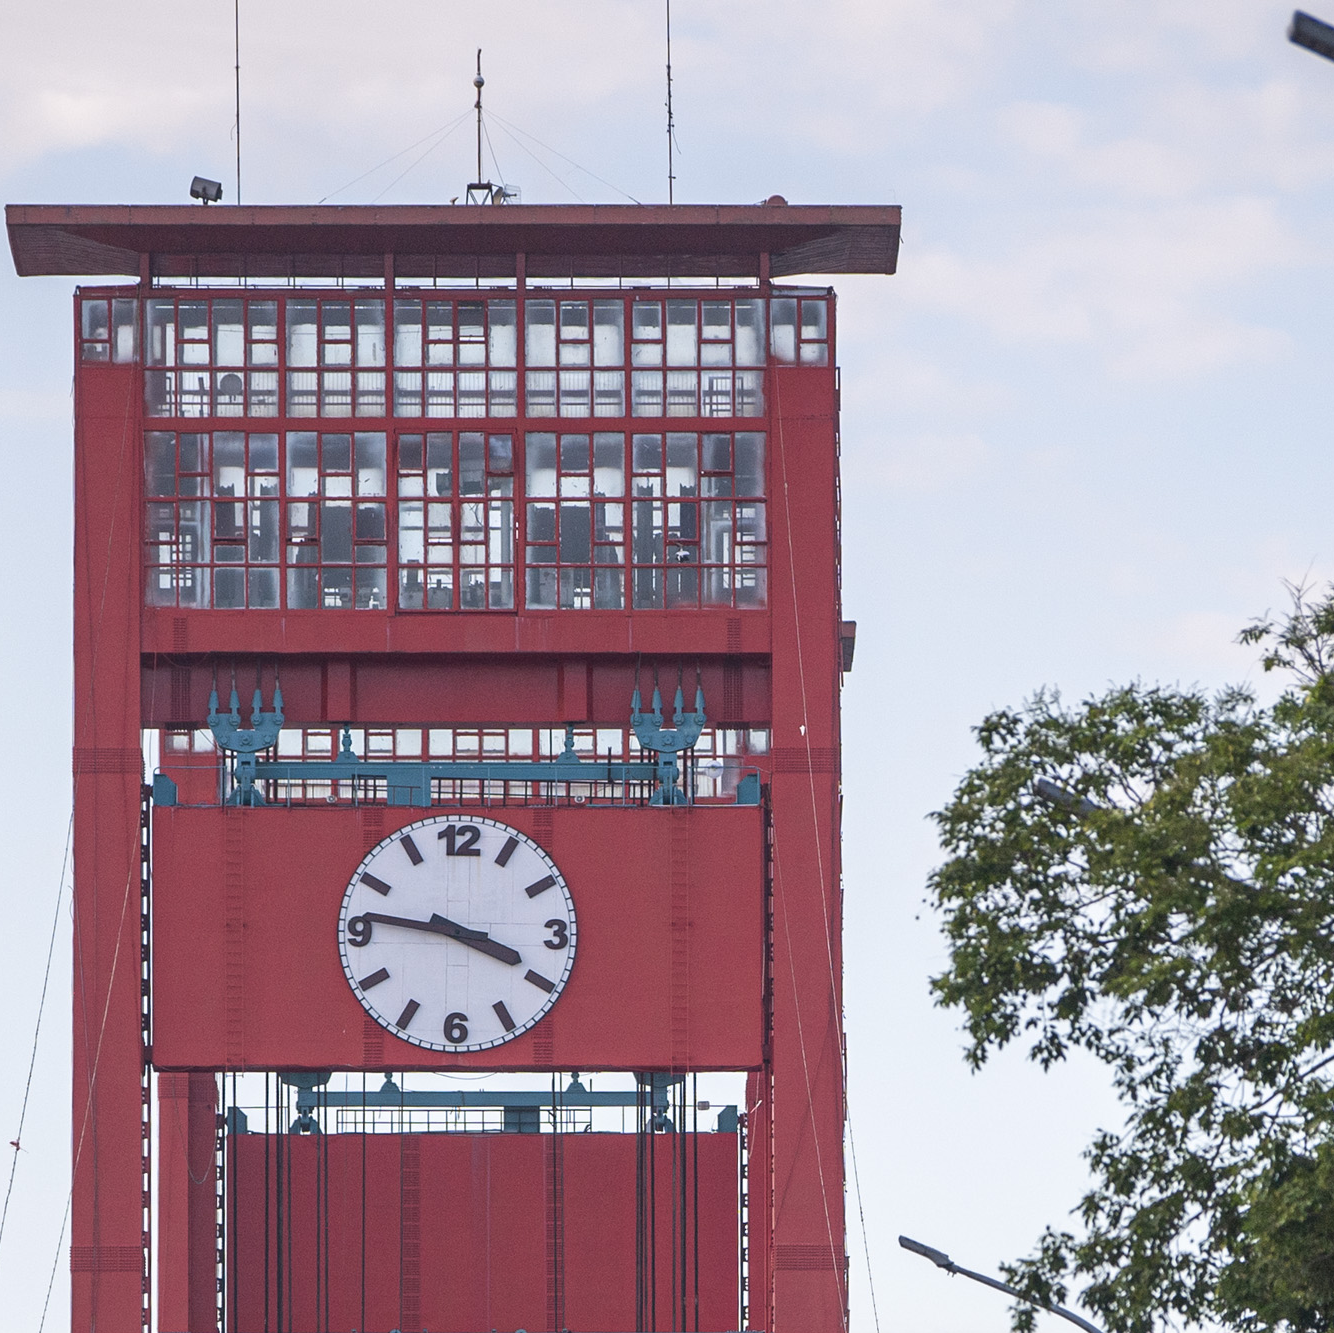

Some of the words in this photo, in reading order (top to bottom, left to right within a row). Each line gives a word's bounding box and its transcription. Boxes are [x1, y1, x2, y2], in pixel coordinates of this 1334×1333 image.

[437, 824, 481, 857] 12
[347, 915, 372, 947] 9
[543, 918, 569, 950] 3
[443, 1012, 469, 1044] 6
